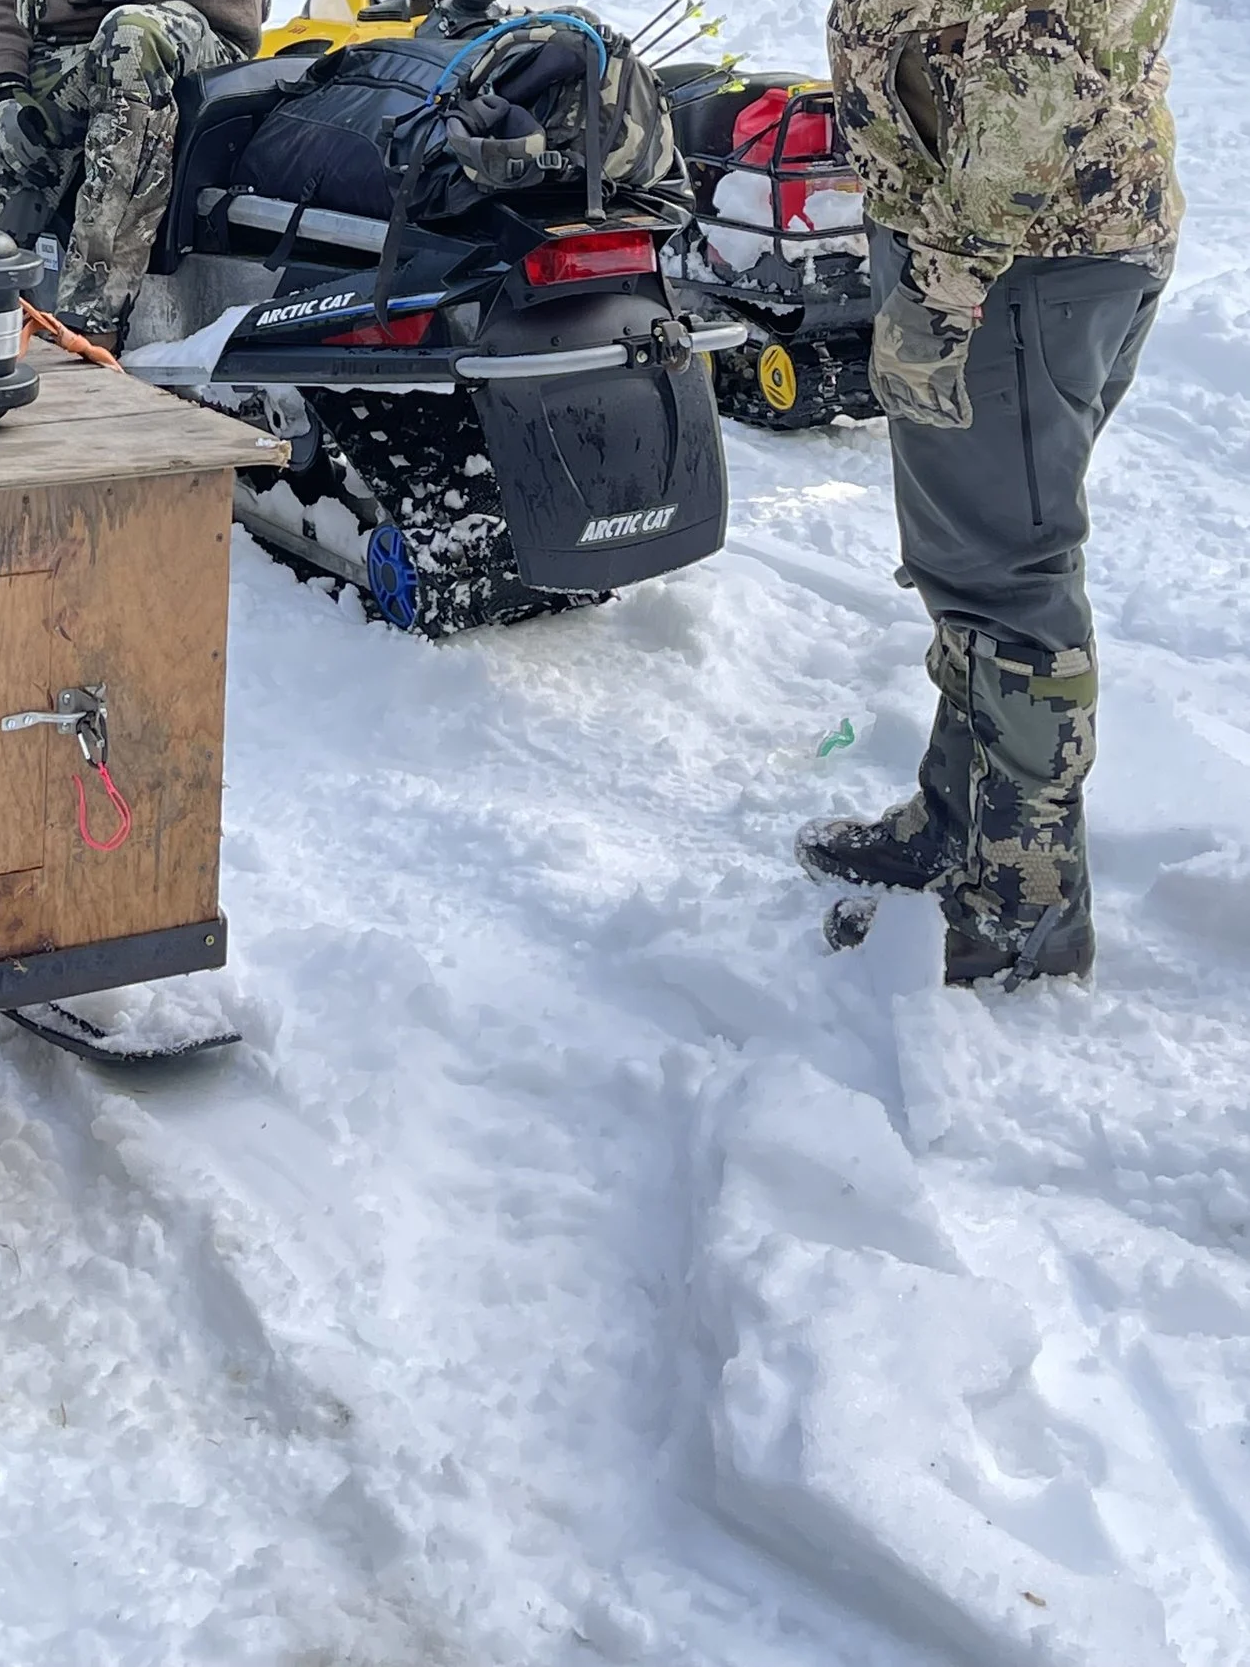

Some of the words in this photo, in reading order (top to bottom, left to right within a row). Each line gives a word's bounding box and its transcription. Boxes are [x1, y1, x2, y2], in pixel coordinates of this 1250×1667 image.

[256, 299, 318, 326] ARCTIC
[319, 292, 356, 311] CAT
[580, 513, 643, 542] ARCTIC
[642, 507, 675, 531] CAT
